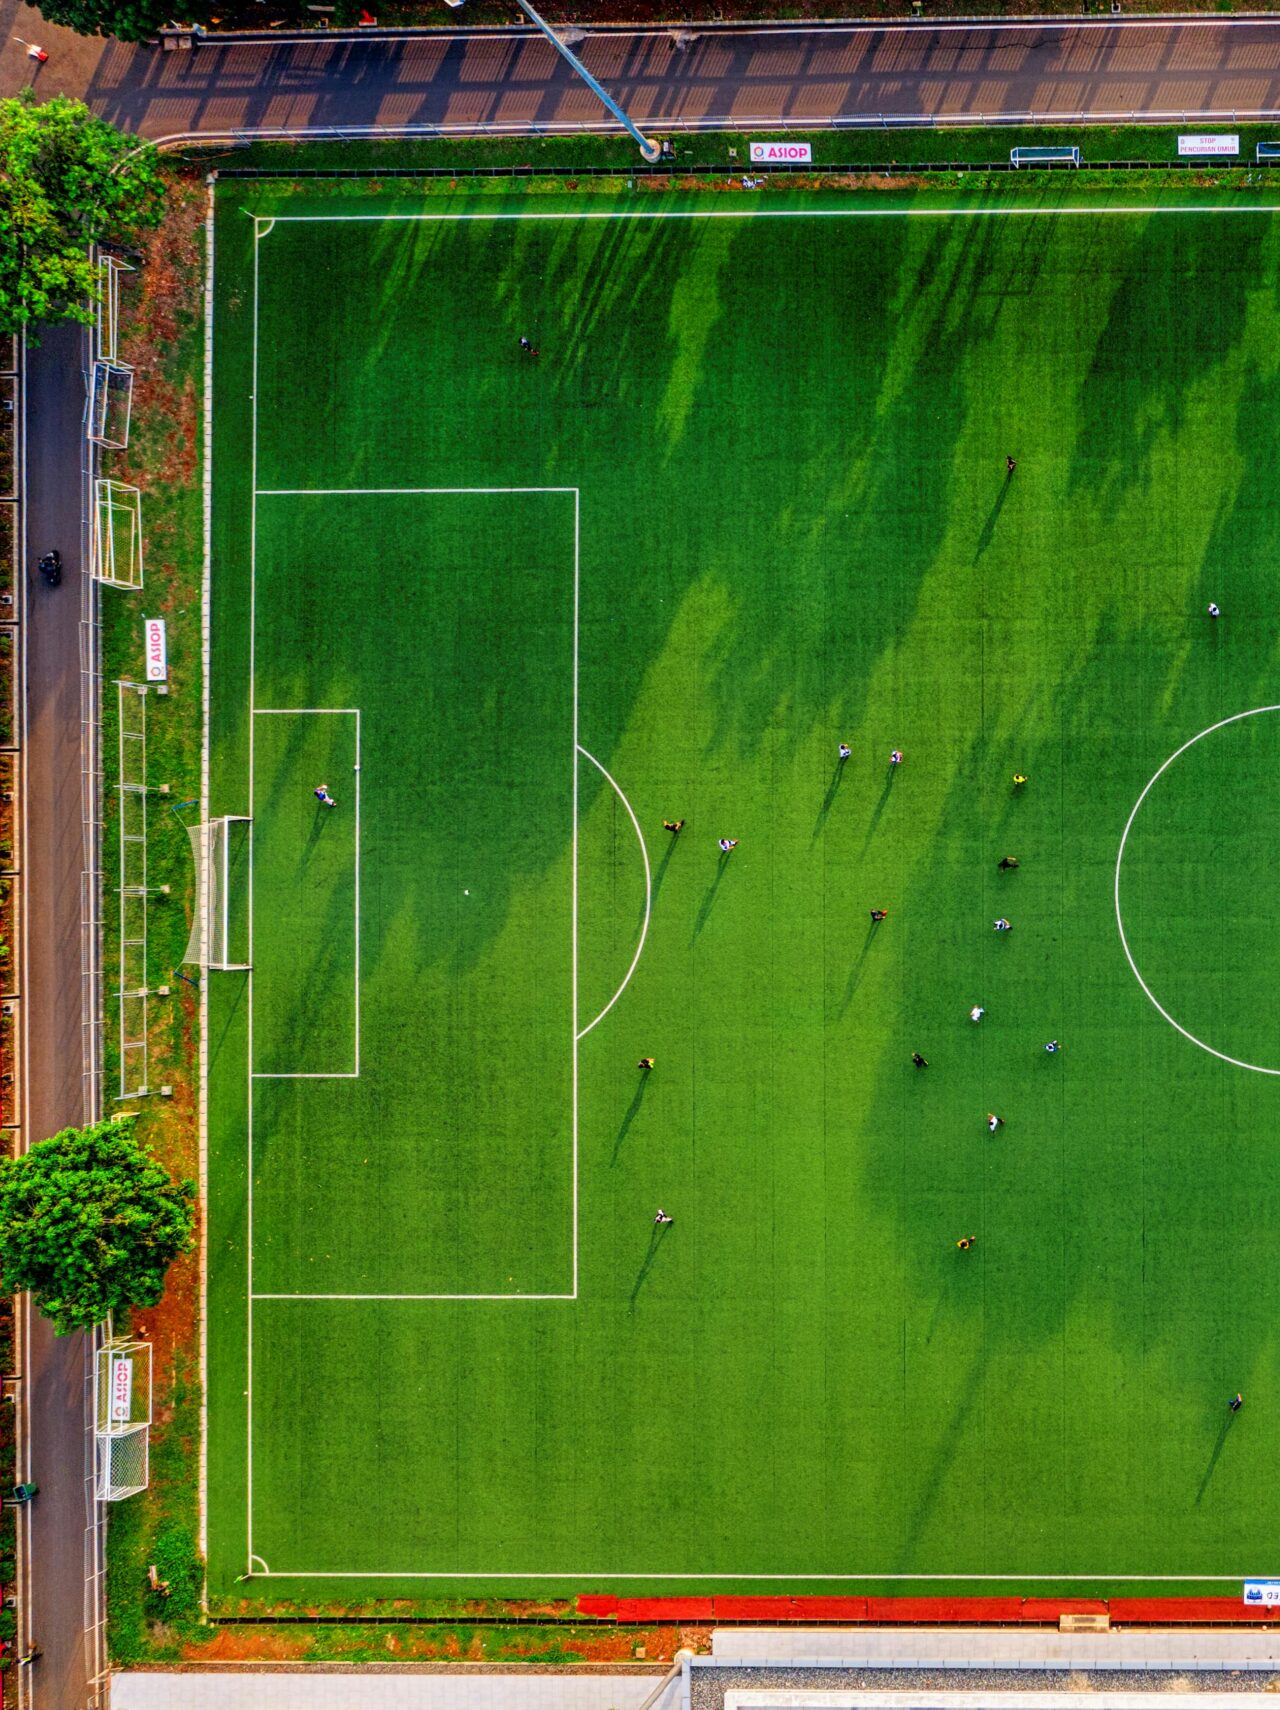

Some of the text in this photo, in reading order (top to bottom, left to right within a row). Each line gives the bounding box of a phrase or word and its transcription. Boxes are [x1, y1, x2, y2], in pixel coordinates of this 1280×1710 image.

[768, 147, 808, 158] ASIOP
[150, 623, 161, 662] ASIOP
[115, 1362, 128, 1402] ASIOP
